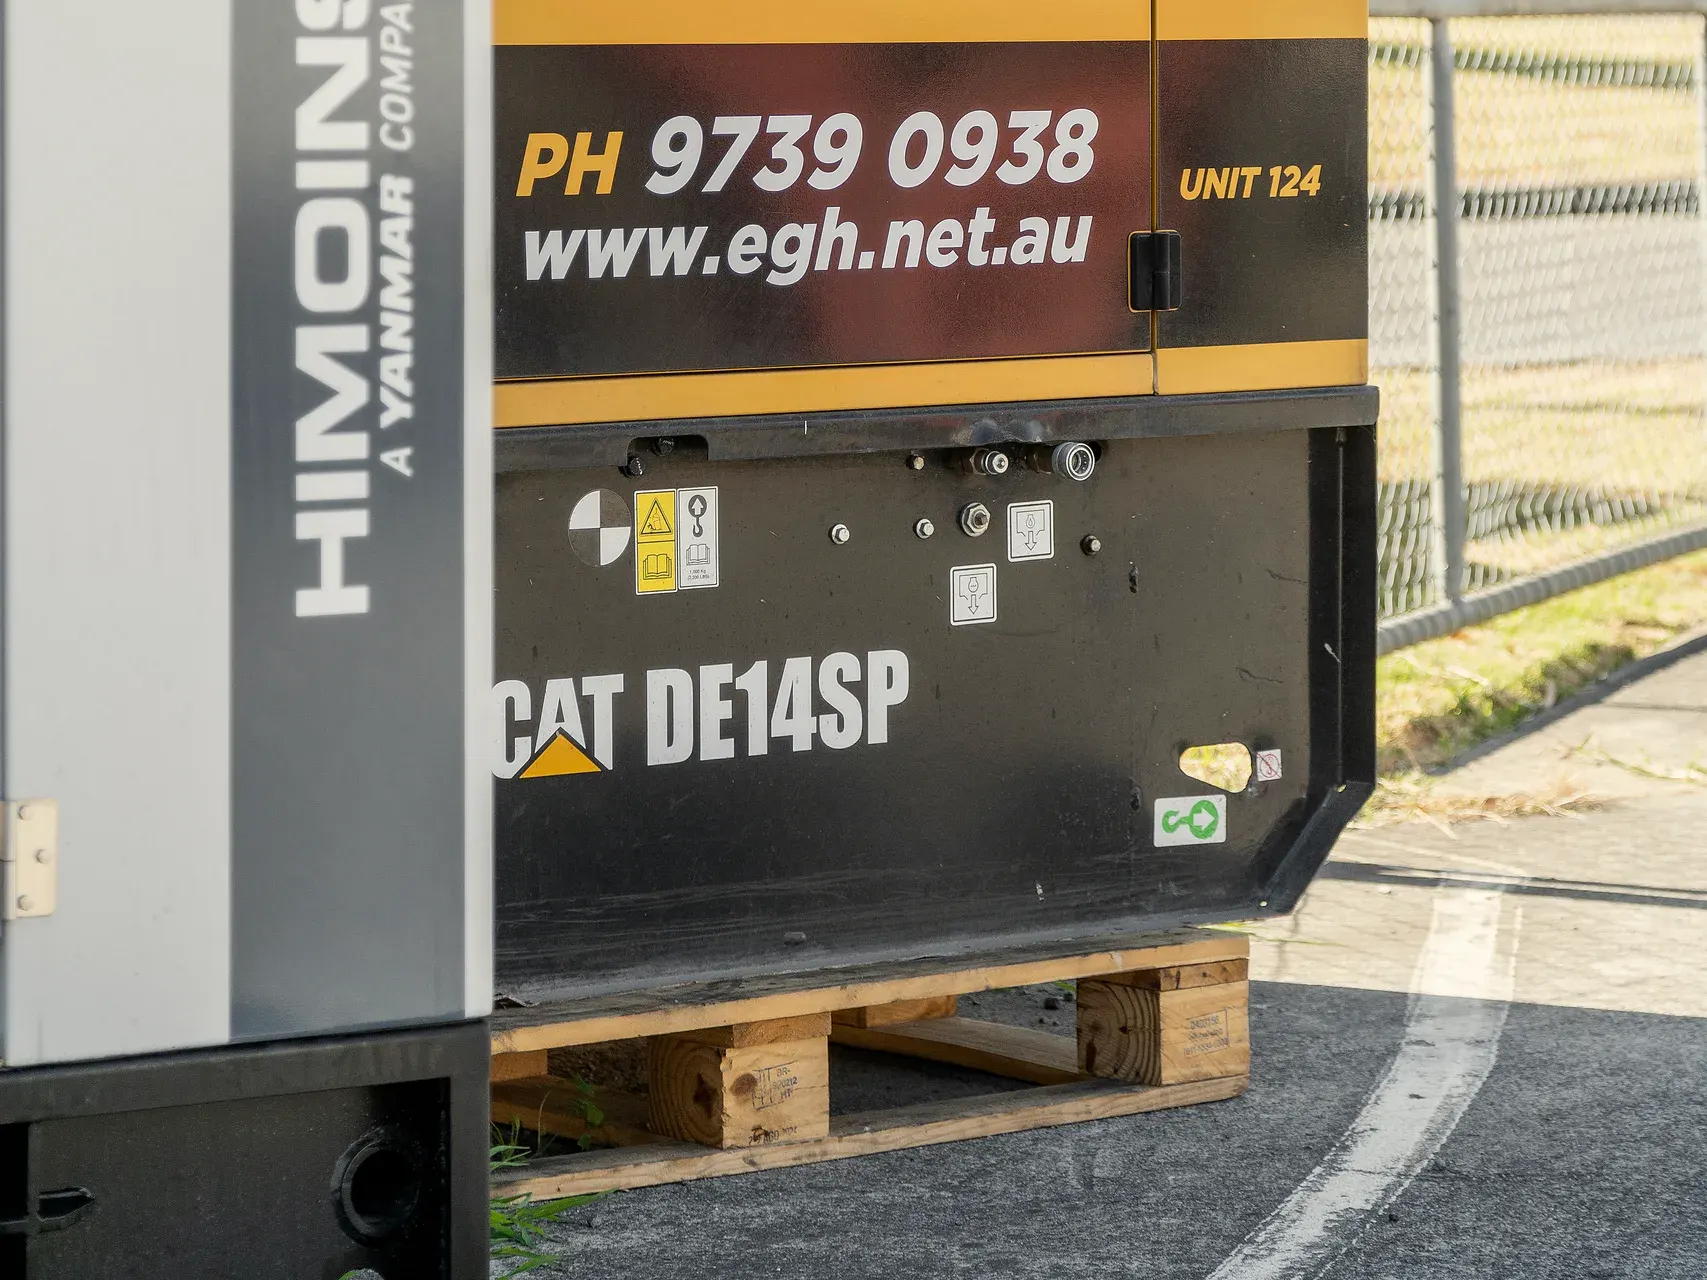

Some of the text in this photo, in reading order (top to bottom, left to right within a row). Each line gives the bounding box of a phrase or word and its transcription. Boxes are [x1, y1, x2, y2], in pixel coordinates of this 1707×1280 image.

[515, 108, 1099, 197] PH 9739 0938
[1179, 164, 1322, 201] UNIT 124
[524, 206, 1093, 287] www.egh.net.au
[379, 173, 416, 430] YANMAR
[379, 445, 416, 480] A
[492, 649, 910, 780] CAT DE14SP
